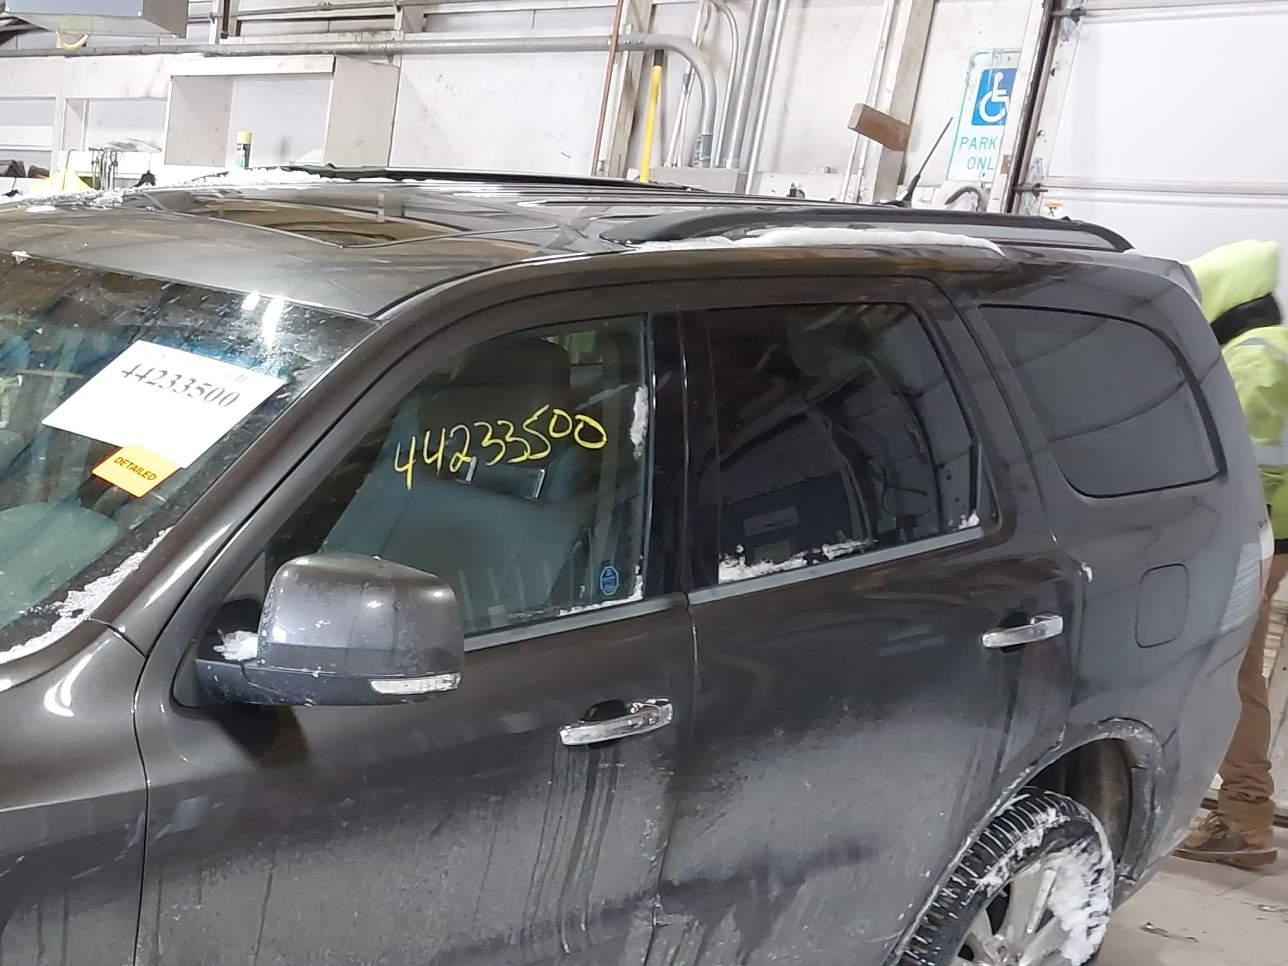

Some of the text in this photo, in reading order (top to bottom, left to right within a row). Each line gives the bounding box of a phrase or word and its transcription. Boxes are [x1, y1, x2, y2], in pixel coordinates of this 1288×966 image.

[959, 136, 998, 151] PARK
[967, 156, 995, 171] ONL
[120, 363, 241, 408] 44233500
[394, 404, 607, 490] 44233500
[113, 456, 157, 482] DETAILED
